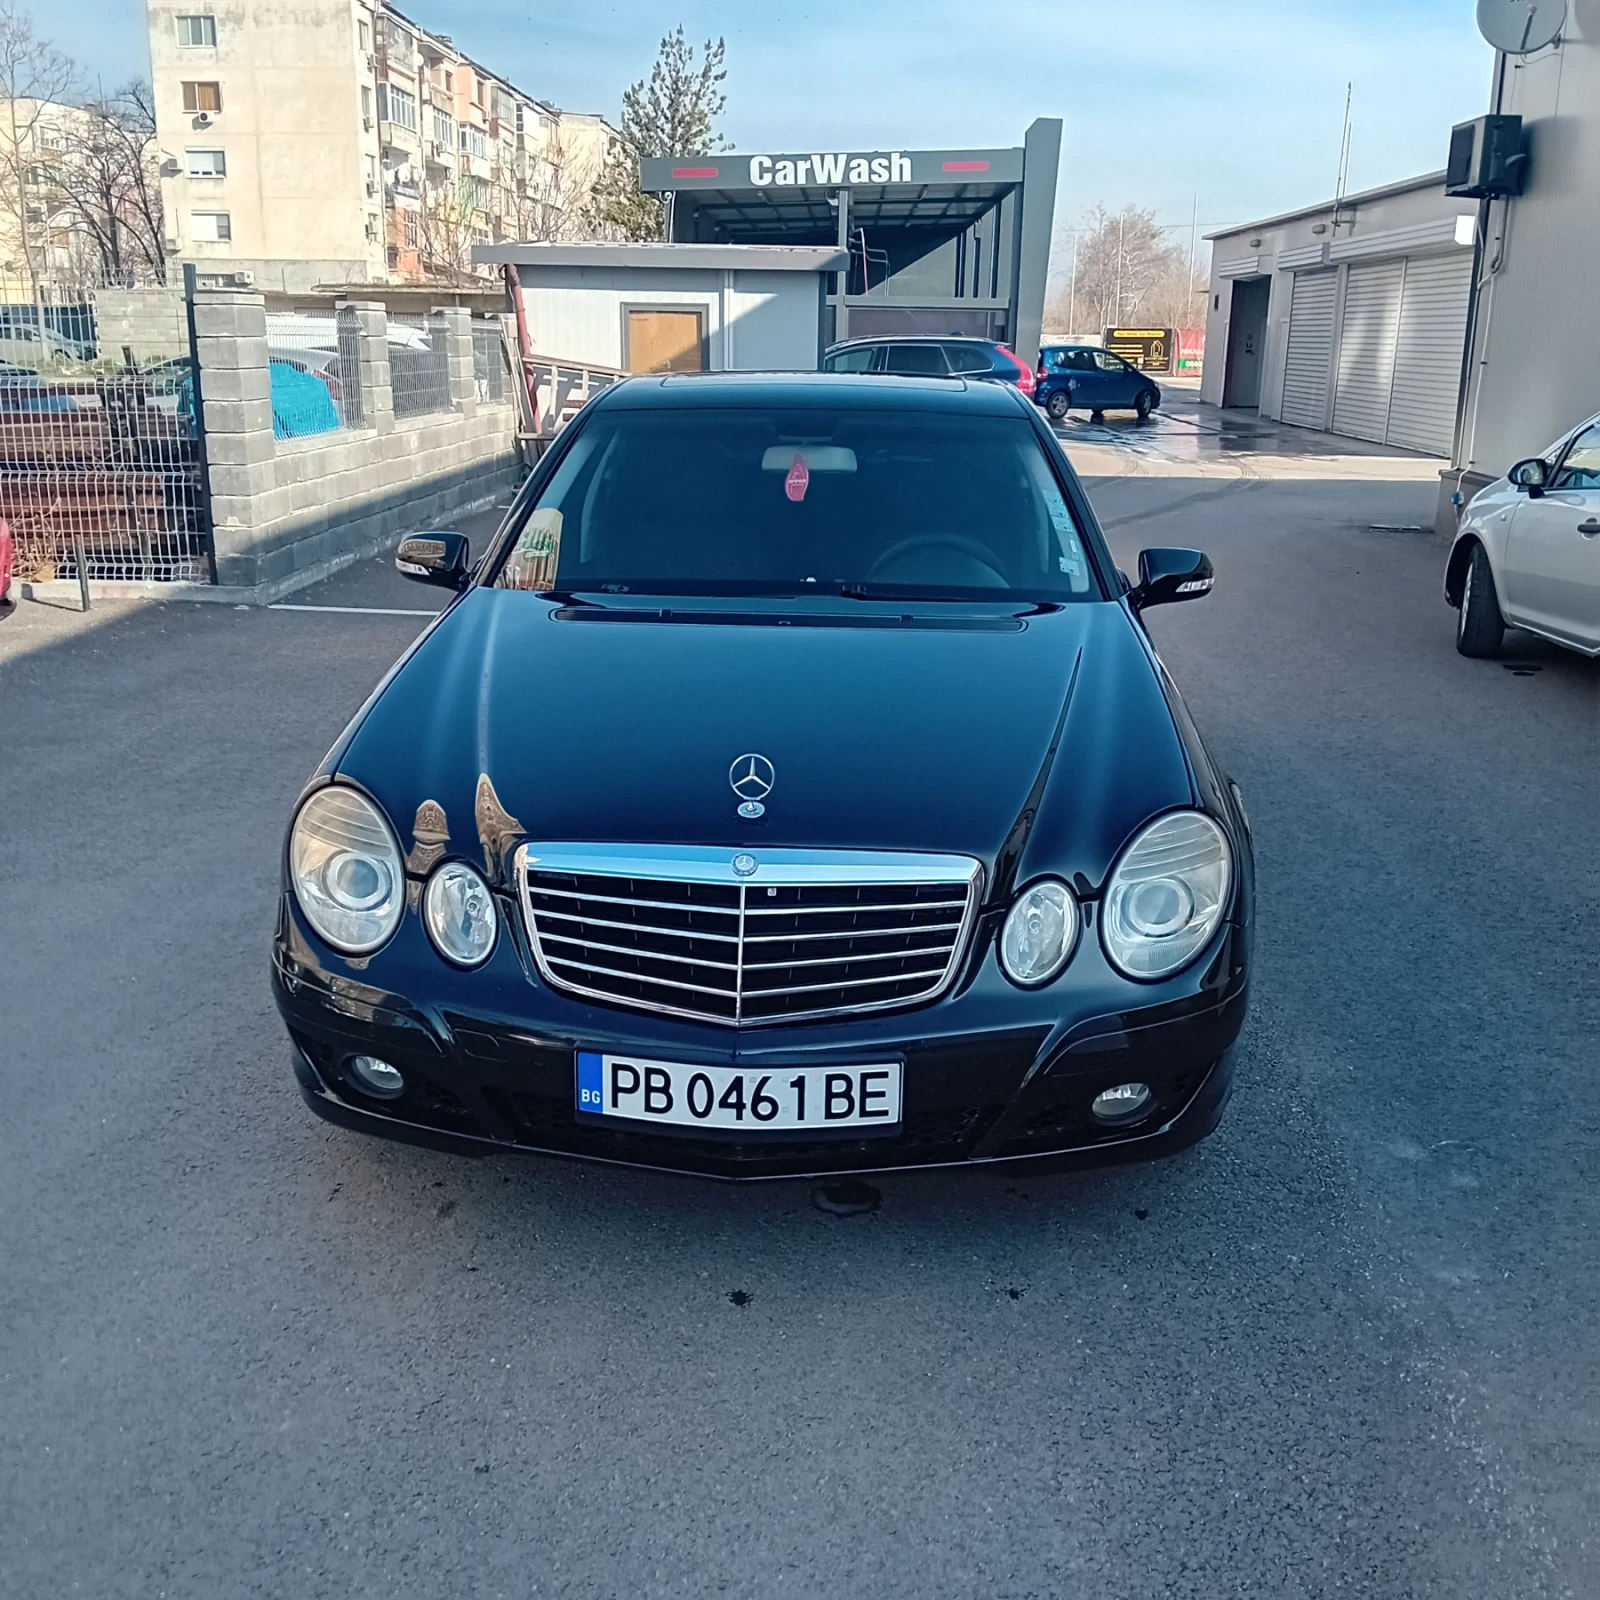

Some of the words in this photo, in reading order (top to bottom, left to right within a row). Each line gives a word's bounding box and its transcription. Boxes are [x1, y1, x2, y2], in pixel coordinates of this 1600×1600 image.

[749, 152, 912, 186] CarWash
[581, 1088, 601, 1105] BG
[611, 1062, 674, 1114] PB
[686, 1072, 806, 1122] 0461
[824, 1071, 890, 1120] BE
